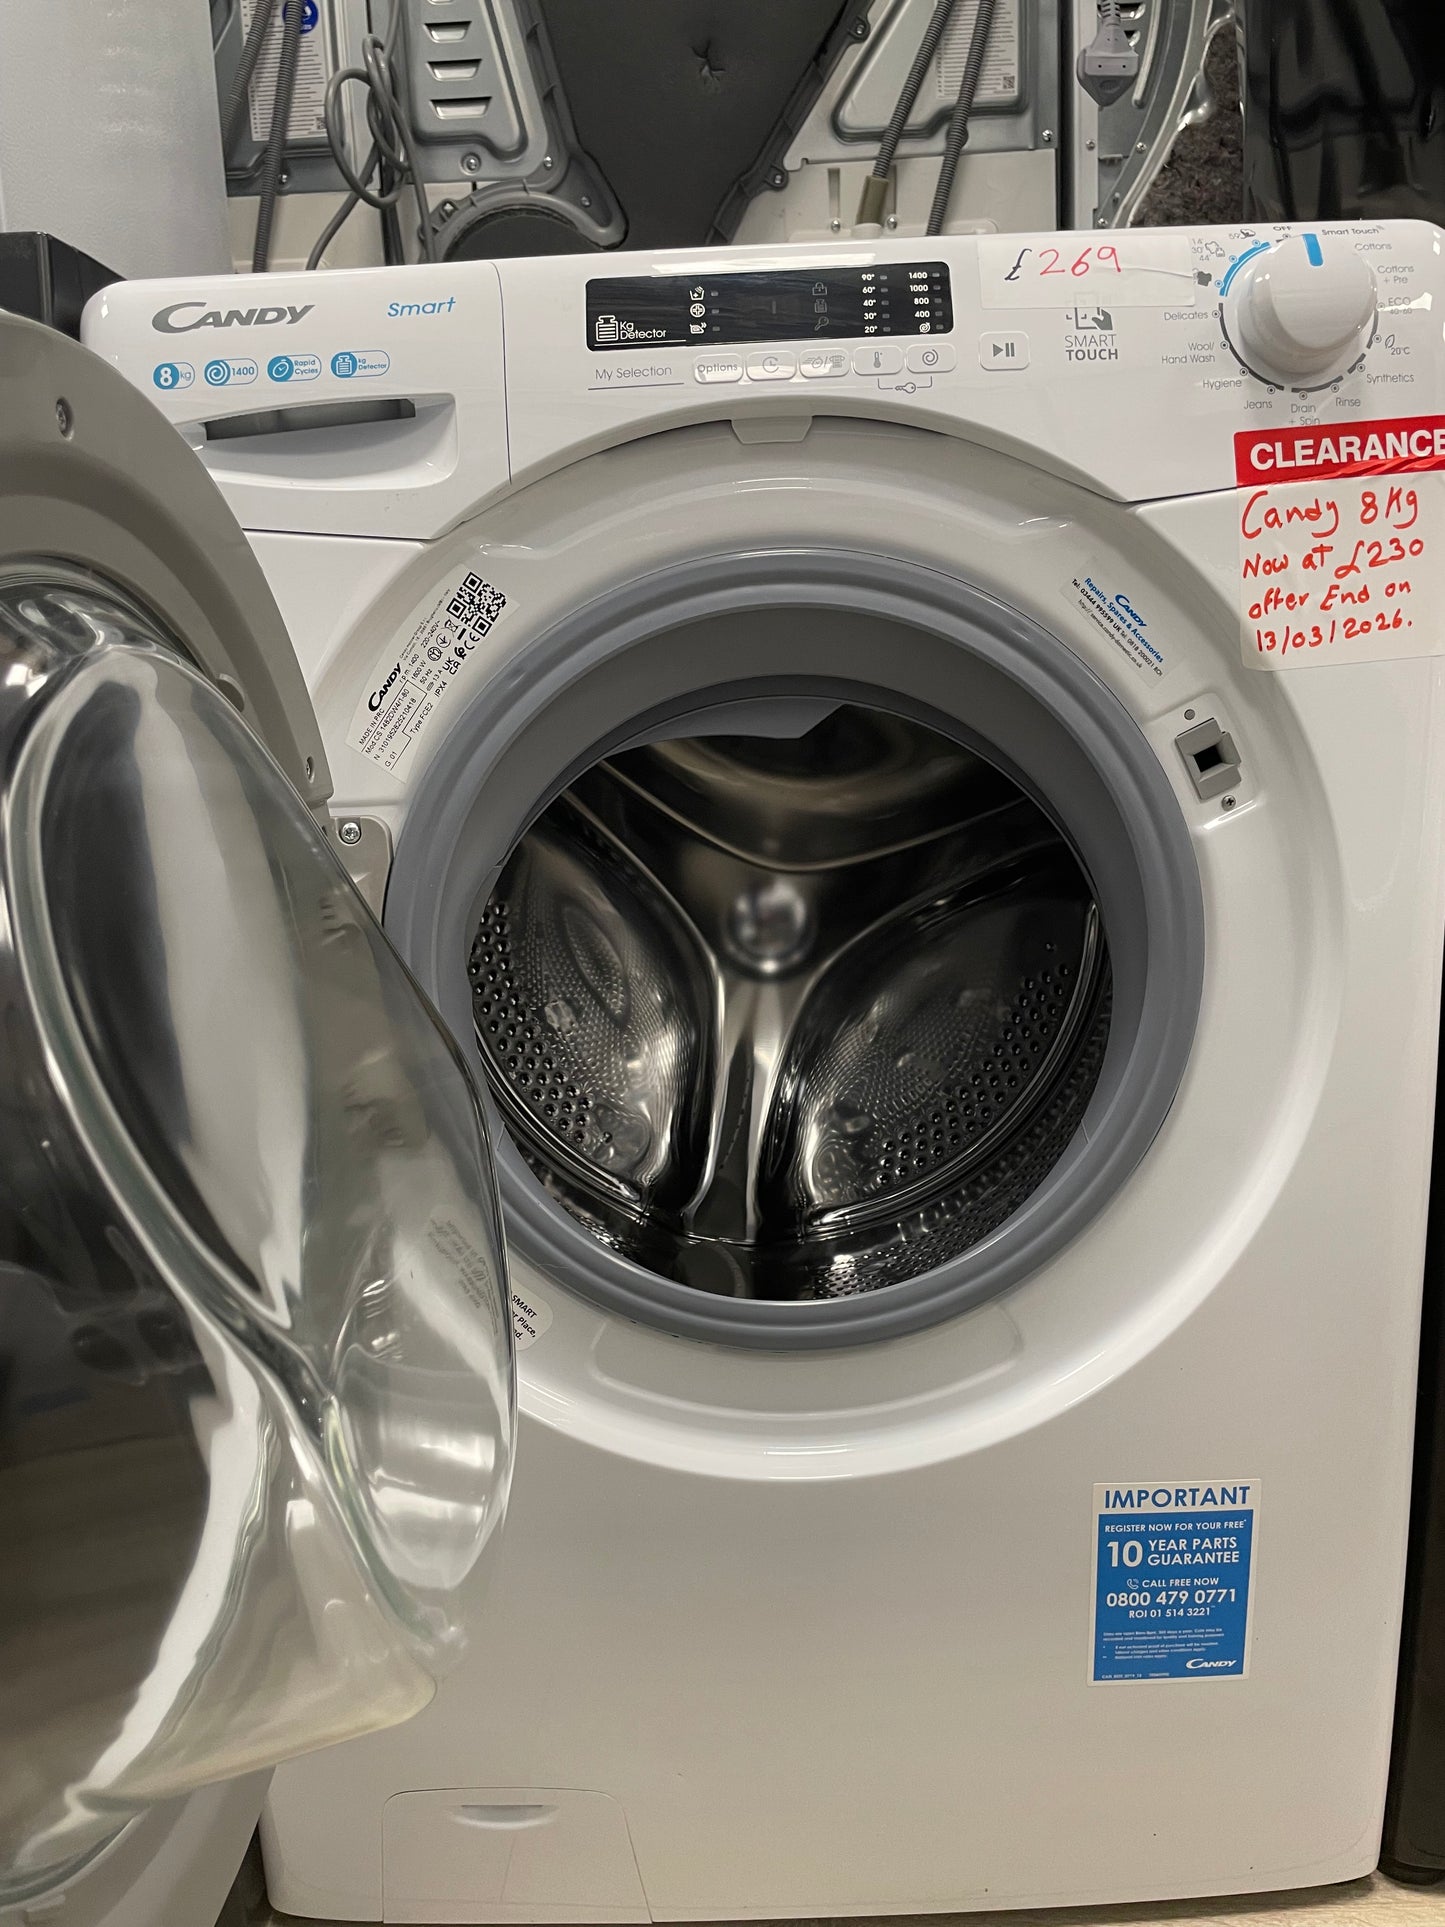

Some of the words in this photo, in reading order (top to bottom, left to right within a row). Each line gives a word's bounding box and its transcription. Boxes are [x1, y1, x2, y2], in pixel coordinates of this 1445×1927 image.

[1321, 228, 1349, 236] Smart
[1354, 242, 1392, 251] Cottons
[908, 271, 928, 279] 1400
[1377, 265, 1415, 274] Cottons
[1393, 275, 1408, 284] Pre
[909, 284, 929, 292] 1000
[914, 297, 930, 305] 800
[1388, 296, 1411, 306] ECO
[387, 296, 457, 318] Smart
[914, 310, 930, 318] 400
[1163, 311, 1209, 321] Delicates
[620, 321, 635, 332] Kg
[620, 328, 667, 340] Detector
[1064, 333, 1117, 348] SMART
[1065, 348, 1118, 361] TOUCH
[1161, 355, 1188, 364] Hand
[1189, 353, 1216, 363] Wash
[294, 358, 316, 369] Rapid
[358, 357, 367, 366] kg
[358, 362, 388, 371] Detector
[231, 366, 255, 377] 1400
[294, 366, 319, 376] Cycles
[595, 368, 613, 382] My
[616, 365, 672, 379] Selection
[696, 363, 738, 374] Options
[160, 367, 173, 386] 8
[179, 369, 192, 382] kg
[1366, 373, 1415, 384] Synthetics
[1202, 379, 1243, 391] Hygiene
[1243, 400, 1273, 410] Jeans
[1335, 397, 1361, 407] Rinse
[1290, 403, 1316, 413] Drain
[1300, 416, 1321, 426] Spin
[1241, 490, 1340, 540] Candy
[1333, 537, 1424, 580] £230
[1319, 584, 1371, 612] End
[1384, 580, 1412, 597] on
[1085, 578, 1108, 605] Repairs,
[1107, 601, 1127, 624] Spares
[1131, 628, 1164, 663] Accessories
[1112, 622, 1122, 633] UK
[434, 680, 448, 698] IPX4
[409, 720, 423, 734] Type
[419, 702, 434, 721] FCE2
[359, 727, 373, 746] MADE
[373, 708, 385, 722] PRC
[373, 730, 383, 742] CS
[512, 1294, 538, 1319] SMART
[518, 1316, 537, 1338] Place,
[1104, 1486, 1251, 1509] IMPORTANT
[1104, 1524, 1146, 1533] REGISTER
[1148, 1523, 1173, 1532] NOW
[1174, 1522, 1193, 1531] FOR
[1196, 1521, 1221, 1530] YOUR
[1148, 1538, 1187, 1552] YEAR
[1192, 1536, 1237, 1550] PARTS
[1107, 1540, 1143, 1568] 10
[1147, 1551, 1240, 1566] GUARANTEE
[1141, 1579, 1167, 1588] CALL
[1169, 1578, 1191, 1587] FREE
[1193, 1577, 1220, 1586] NOW
[1106, 1591, 1151, 1607] 0800
[1155, 1590, 1189, 1605] 479
[1194, 1588, 1237, 1604] 0771
[1128, 1609, 1148, 1619] ROI
[1150, 1609, 1162, 1618] 01
[1165, 1608, 1184, 1617] 514
